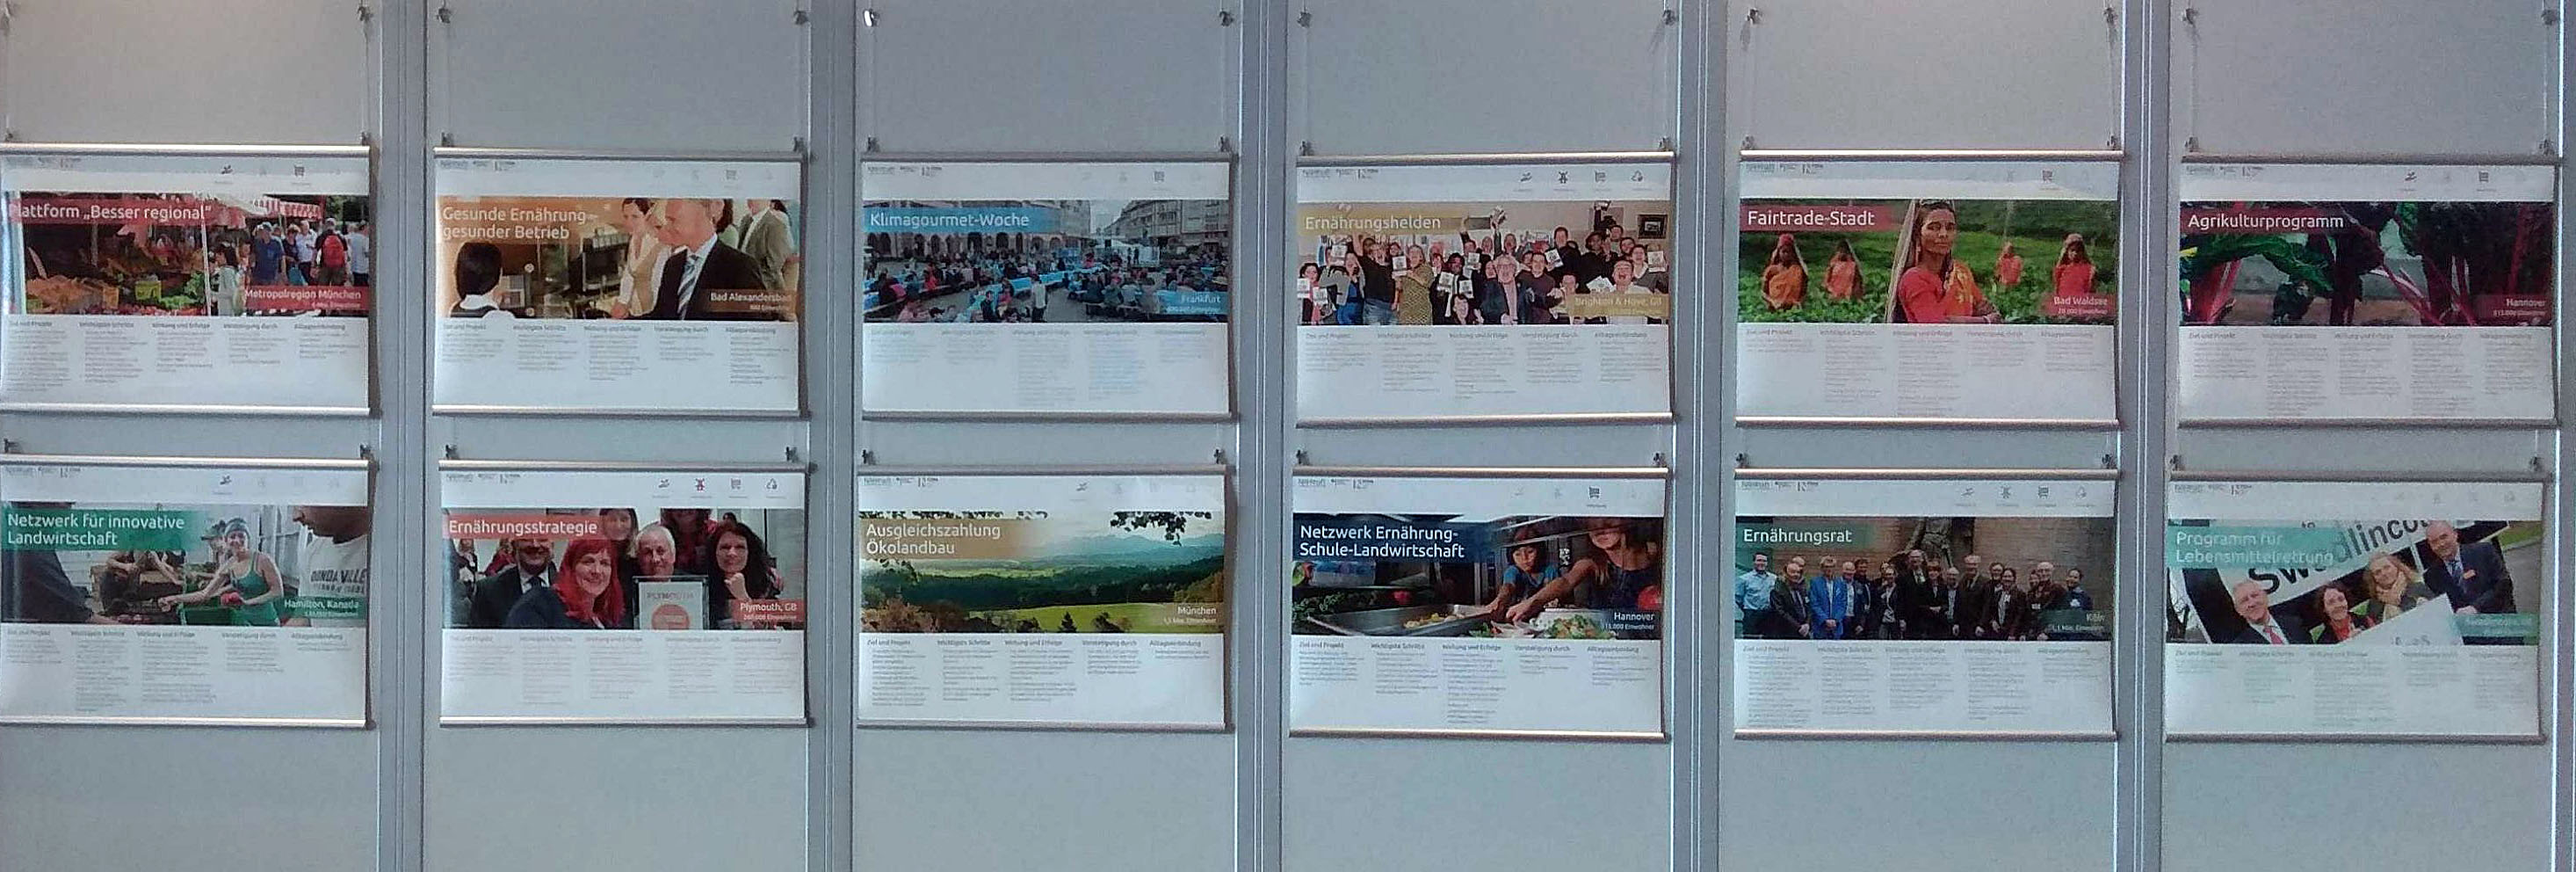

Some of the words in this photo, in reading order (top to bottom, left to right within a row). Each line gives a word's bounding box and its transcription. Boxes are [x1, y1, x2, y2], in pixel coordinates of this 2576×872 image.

[442, 207, 506, 221] Gesunde
[870, 213, 1030, 229] Klimagourmet-Woche
[1747, 210, 1876, 226] Fairtrade-Stadt
[2188, 214, 2344, 230] Agrikulturprogramm
[1306, 215, 1441, 232] Ernährungshelden
[443, 224, 510, 240] gesunder
[515, 226, 569, 239] Betrieb
[245, 289, 316, 301] Metropolregion
[318, 289, 361, 300] München
[710, 293, 727, 302] Bad
[1181, 294, 1221, 304] Frankfurt
[2054, 296, 2071, 305] Bad
[2073, 296, 2108, 306] Waldsee
[8, 513, 78, 528] Netzwerk
[83, 513, 104, 527] für
[108, 514, 185, 529] innovative
[449, 520, 598, 537] Ernährungsstrategie
[8, 531, 118, 546] Landwirtschaft
[866, 523, 1001, 541] Ausgleichszahlung
[1300, 525, 1372, 539] Netzwerk
[1376, 525, 1458, 543] Ernährung-
[1743, 528, 1853, 546] Ernährungsrat
[2176, 531, 2257, 547] Programm
[866, 539, 955, 555] Ökolandbau
[1299, 541, 1465, 558] Schule-Landwirtschaft
[2176, 549, 2334, 564] Lebensmittelrettung
[327, 600, 359, 609] Kanada
[740, 602, 783, 614] Plymouth,
[785, 602, 798, 612] GB
[1177, 606, 1217, 615] München
[1614, 612, 1654, 621] Hannover
